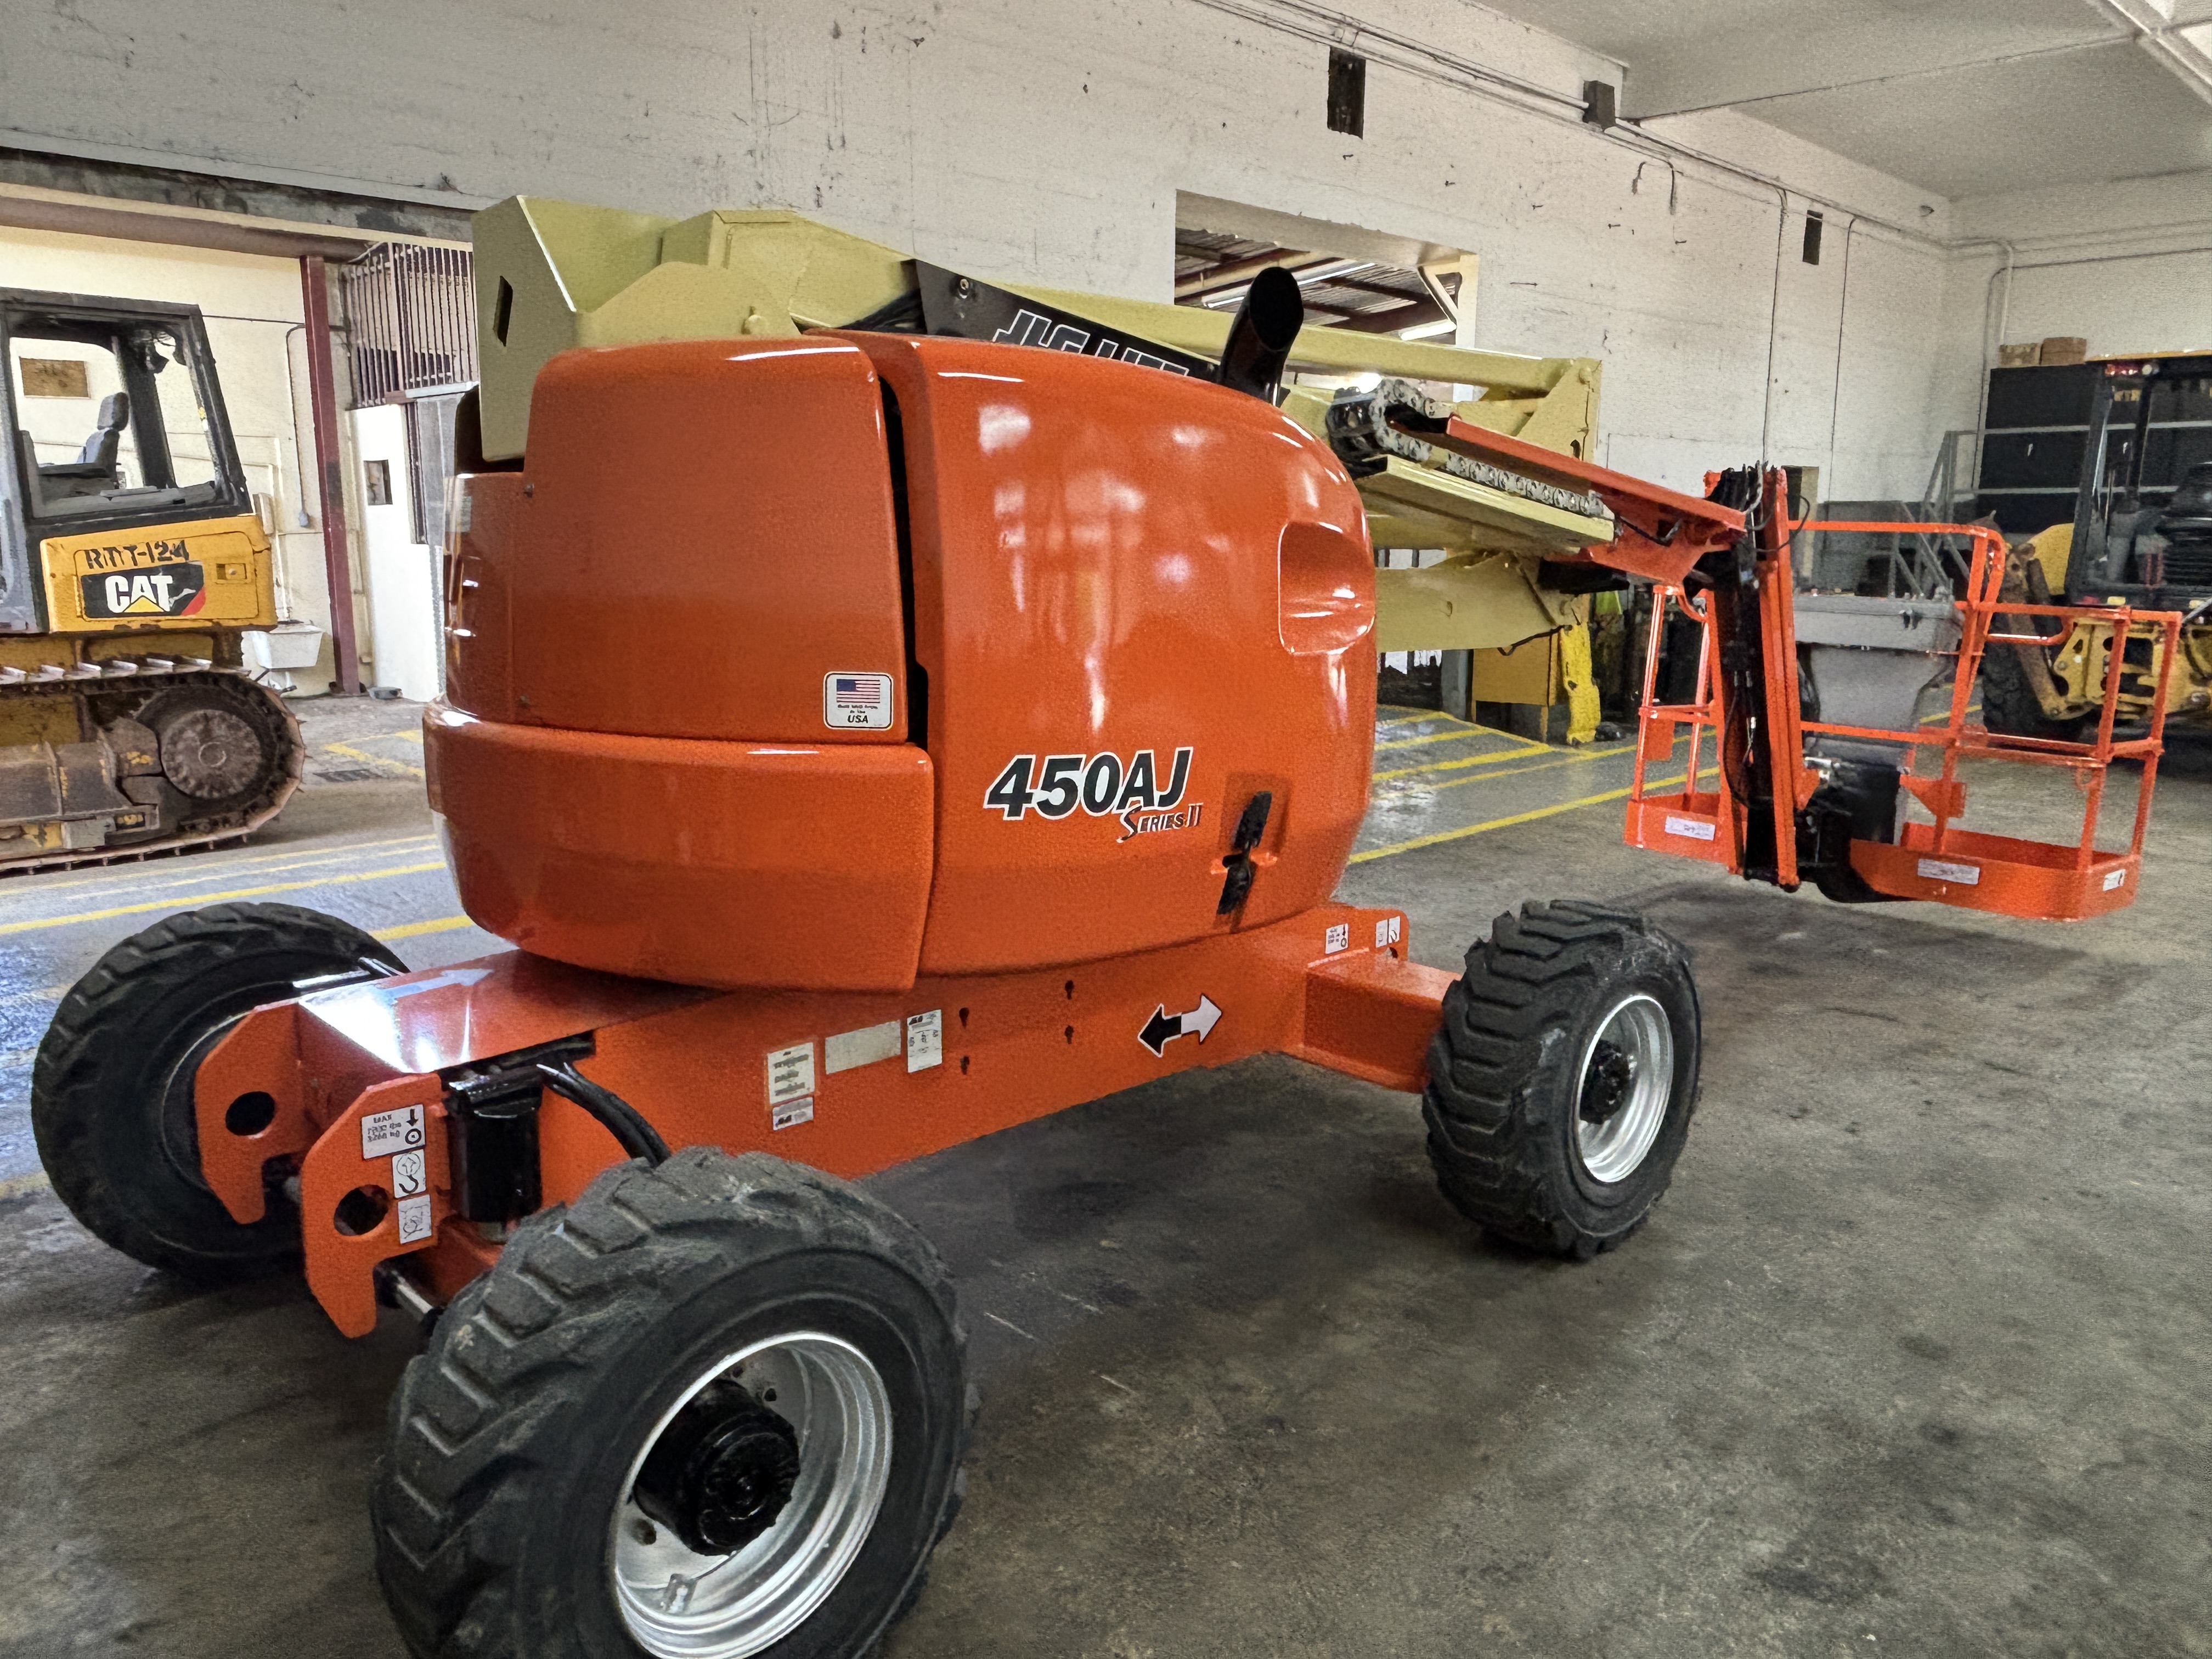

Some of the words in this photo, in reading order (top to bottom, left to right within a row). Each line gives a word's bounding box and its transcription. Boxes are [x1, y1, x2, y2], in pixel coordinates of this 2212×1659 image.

[104, 574, 174, 614] CAT
[847, 715, 868, 724] USA
[983, 746, 1194, 820] 450AJ
